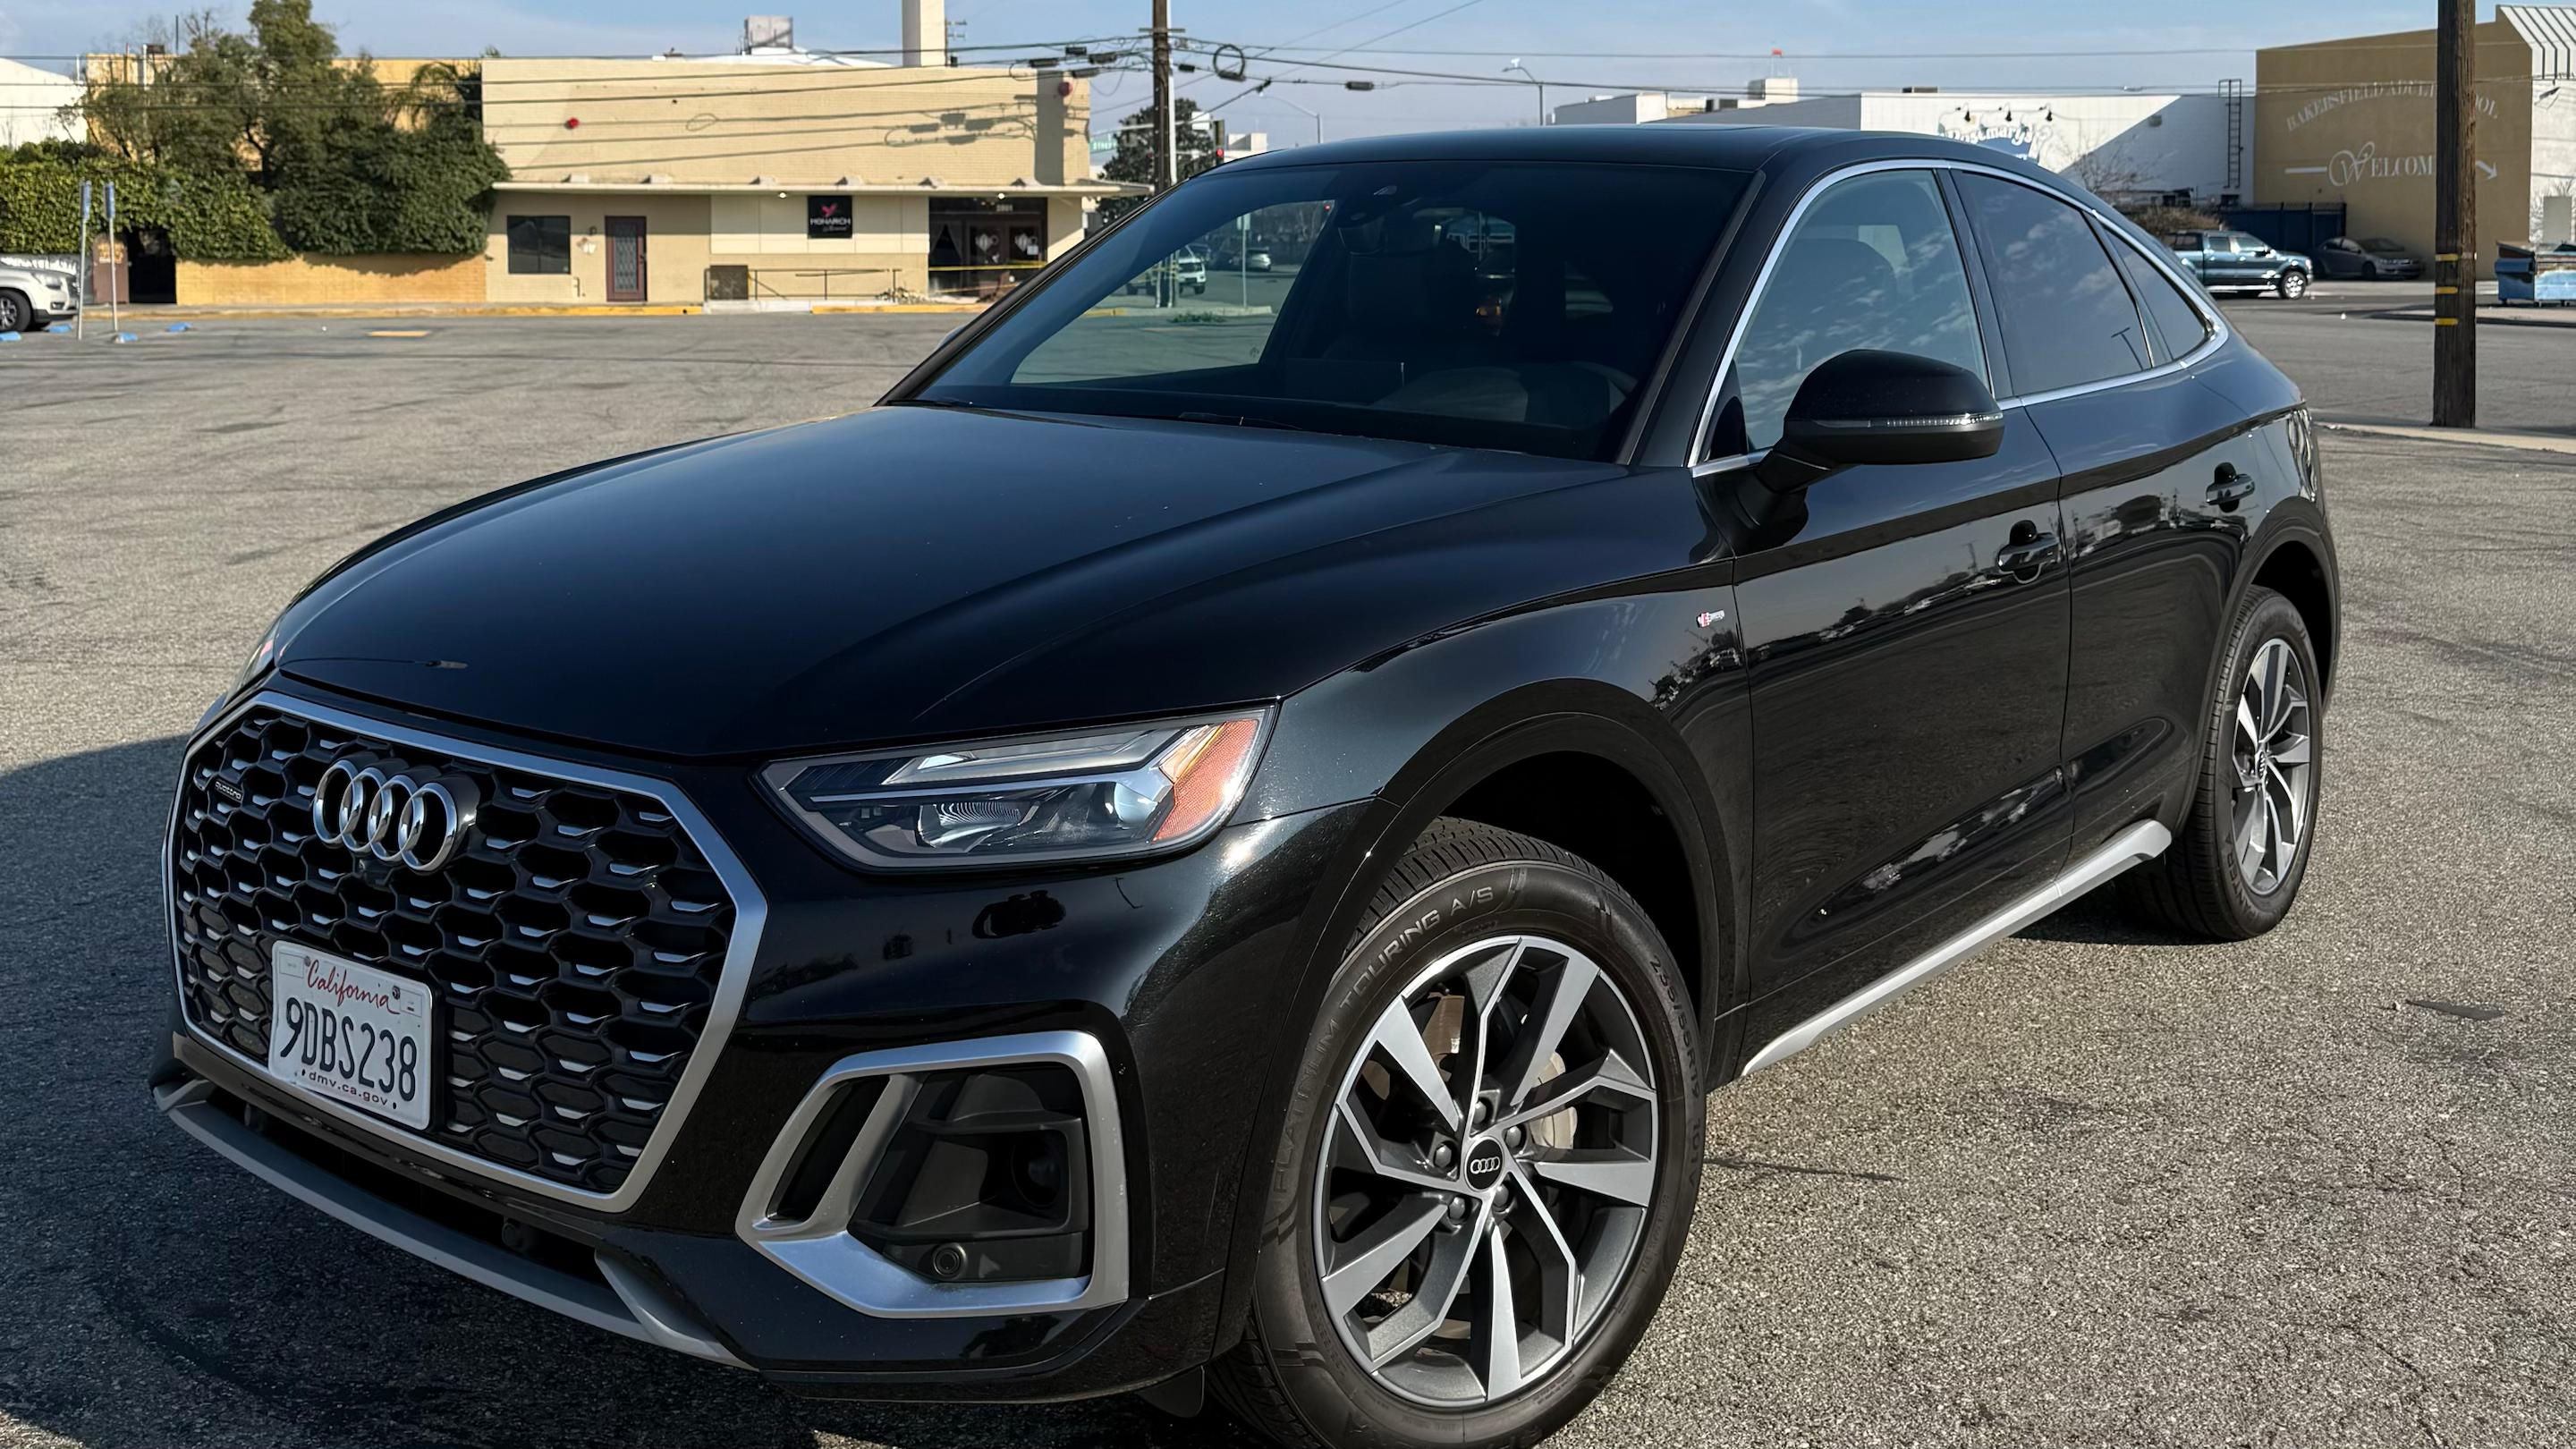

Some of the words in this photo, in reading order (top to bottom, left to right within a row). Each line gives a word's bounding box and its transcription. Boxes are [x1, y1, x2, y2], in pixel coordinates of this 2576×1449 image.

[2328, 140, 2434, 187] WELCOM
[809, 217, 852, 225] MONARCH
[1338, 908, 1441, 1012] TOURING
[1449, 885, 1495, 918] A/S
[307, 959, 401, 1015] California
[280, 996, 418, 1102] 9DBS238
[309, 1071, 388, 1107] dmv.ca.gov
